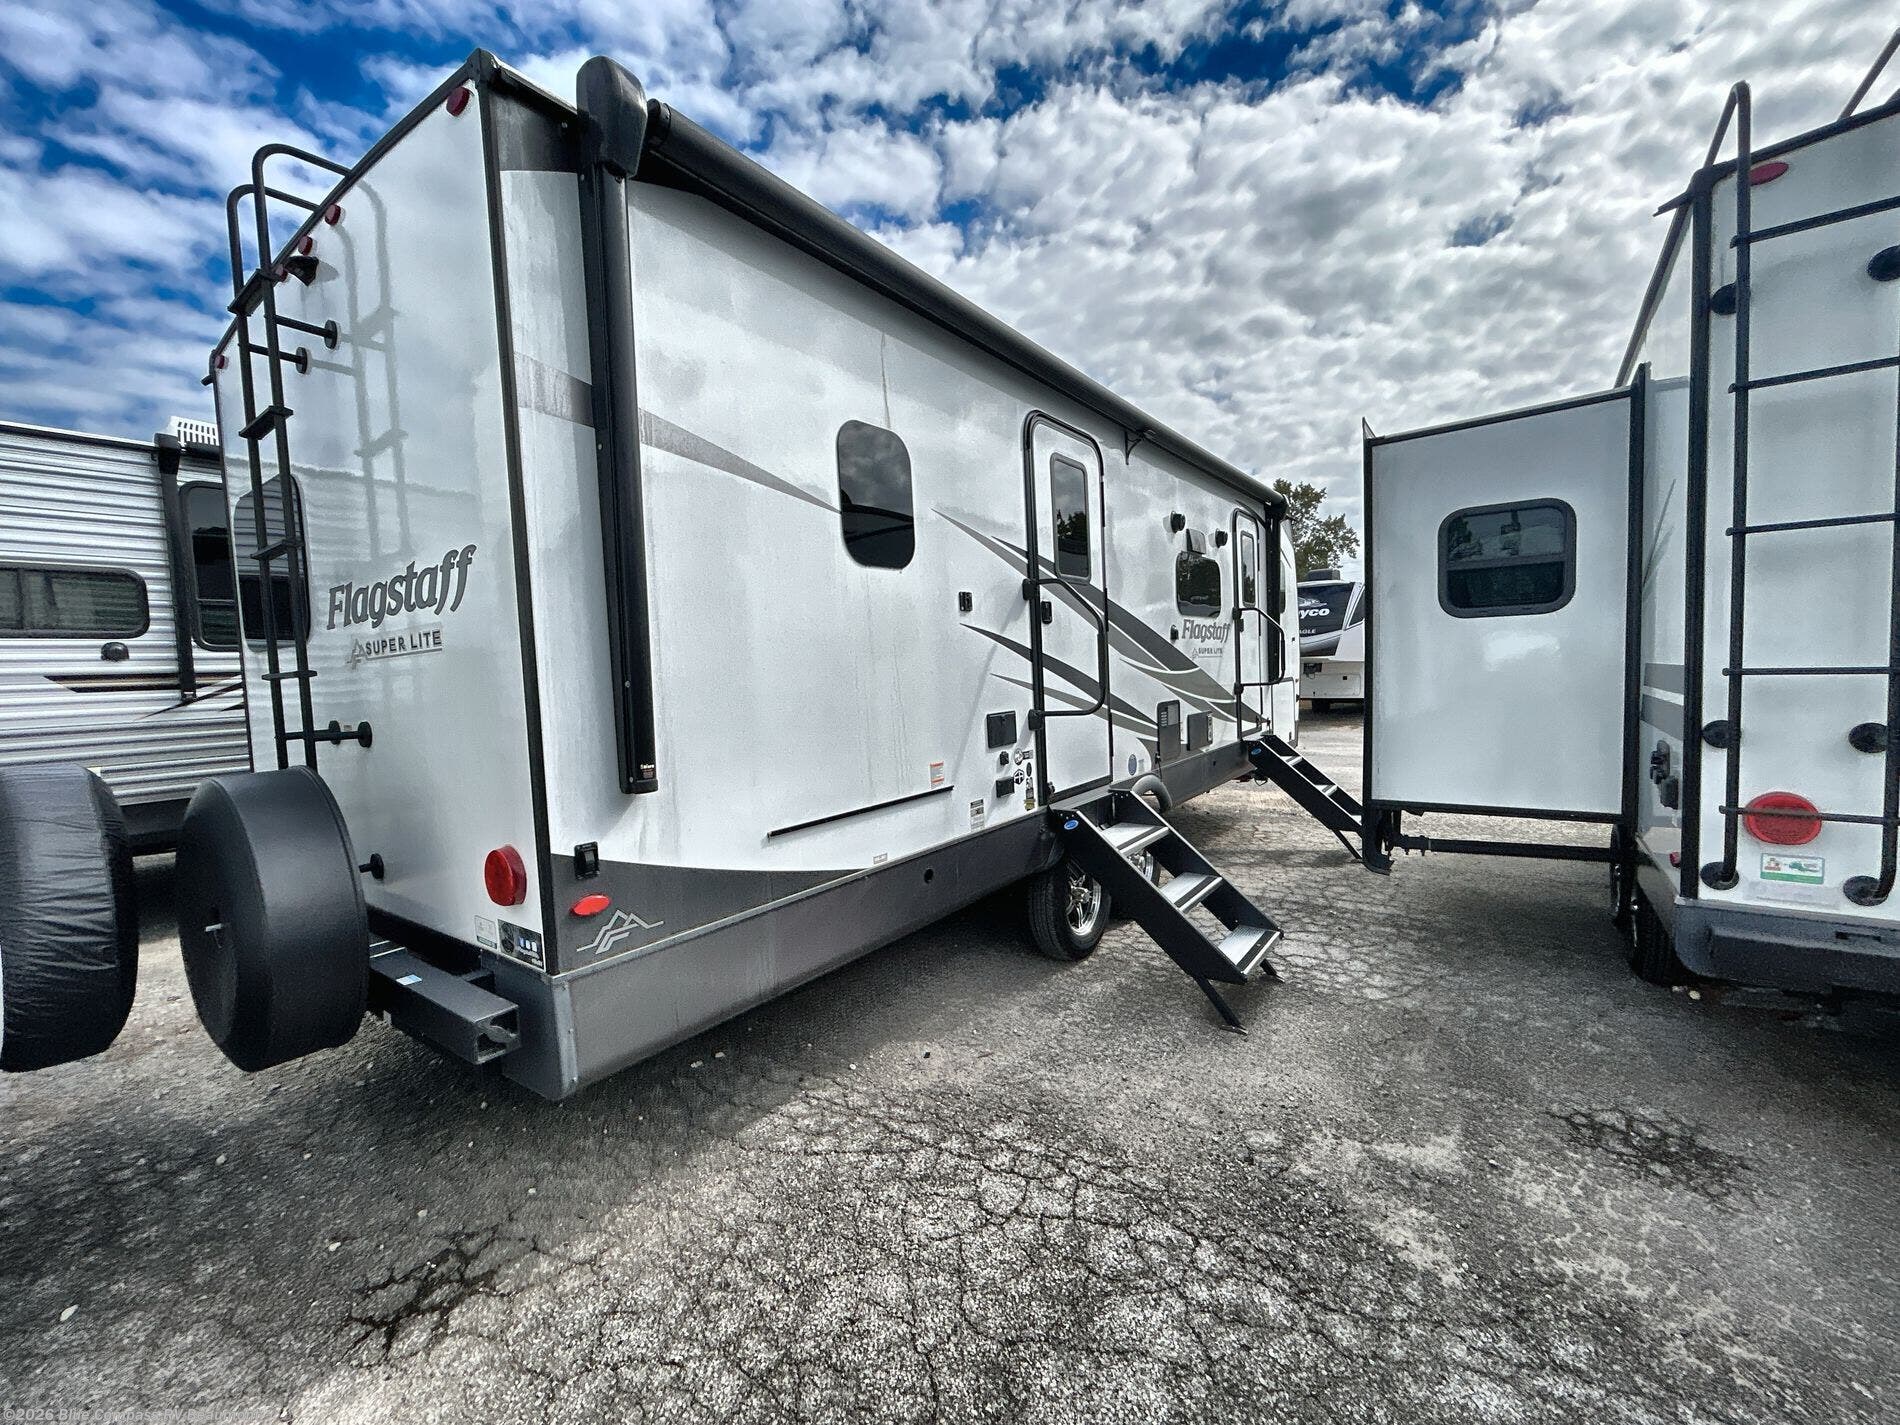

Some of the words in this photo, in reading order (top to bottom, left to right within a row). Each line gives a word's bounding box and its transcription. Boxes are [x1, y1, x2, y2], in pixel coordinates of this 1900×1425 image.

[326, 543, 477, 630] Flagstaff
[1299, 608, 1330, 619] yco
[365, 636, 406, 655] SUPER
[410, 630, 442, 649] LITE
[1182, 618, 1231, 643] Flagstaff
